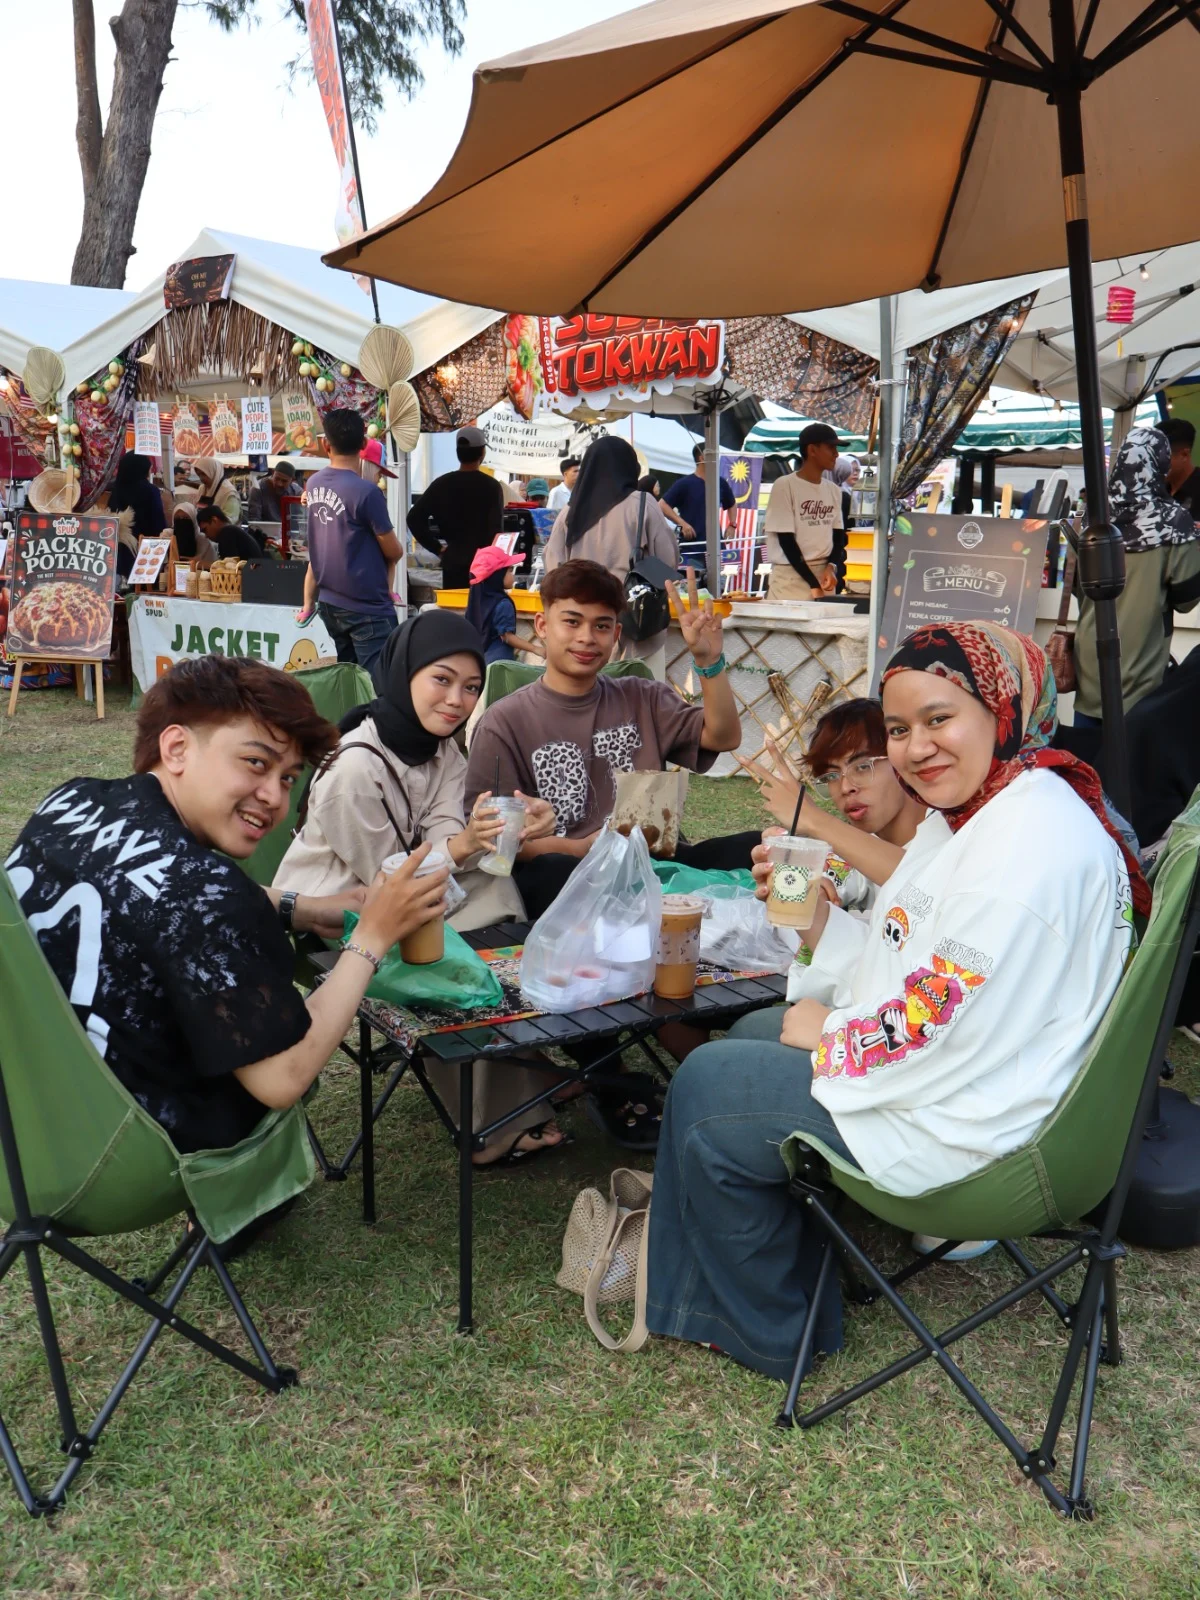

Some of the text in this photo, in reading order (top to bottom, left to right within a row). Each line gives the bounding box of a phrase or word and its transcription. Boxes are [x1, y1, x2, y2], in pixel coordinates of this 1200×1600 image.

[553, 327, 719, 393] TOKWAN
[247, 402, 265, 414] CUTE
[245, 413, 268, 423] PEOPLE
[287, 411, 311, 424] IDAHO
[250, 423, 264, 432] EAT
[492, 424, 538, 436] GLUTEN-FREE
[248, 432, 267, 442] SPUD
[492, 436, 518, 446] HEALTHY
[520, 440, 558, 448] BEVERAGES
[246, 441, 269, 450] POTATO
[800, 500, 834, 520] Hilfiger
[56, 526, 76, 534] SPUD
[21, 537, 110, 560] JACKET
[24, 554, 108, 576] POTATO
[944, 577, 983, 590] MENU
[146, 608, 163, 618] SPUD
[170, 624, 280, 662] JACKET
